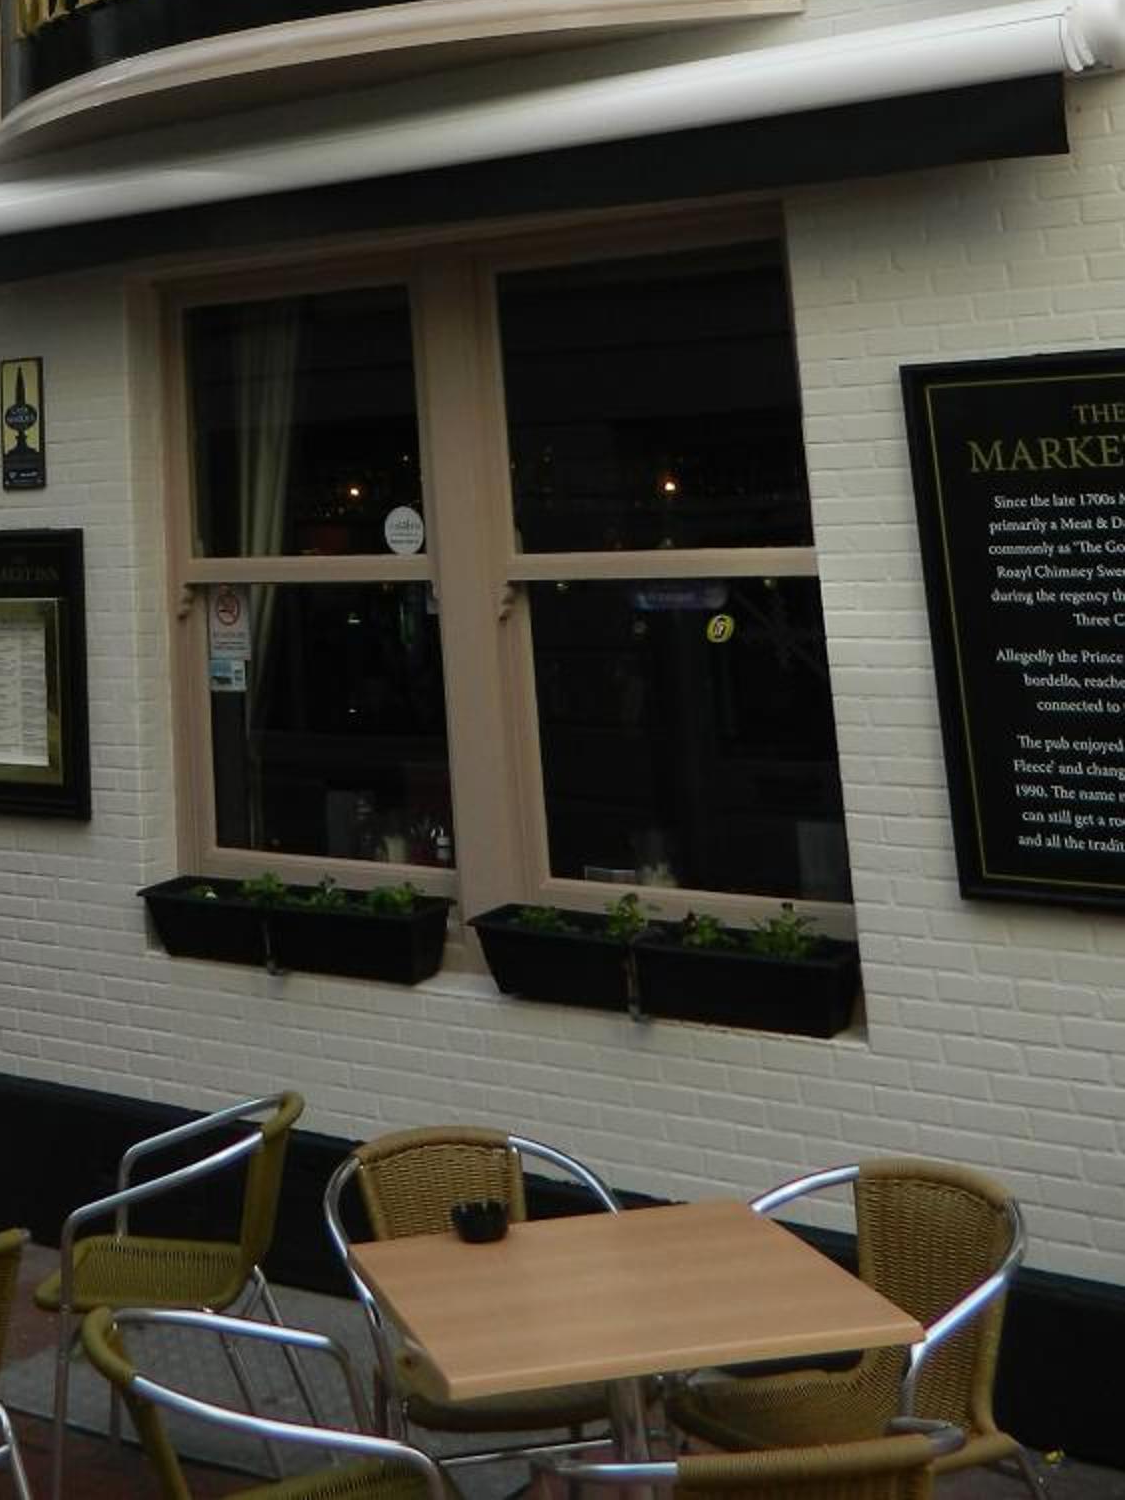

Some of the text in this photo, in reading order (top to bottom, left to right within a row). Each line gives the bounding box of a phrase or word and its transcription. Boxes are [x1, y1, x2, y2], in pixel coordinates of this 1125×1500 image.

[967, 435, 1125, 474] MARKE
[994, 495, 1028, 509] Since
[1030, 492, 1050, 507] the
[1052, 492, 1075, 507] late
[1079, 493, 1115, 506] 1700s
[988, 517, 1048, 536] primarily
[1060, 517, 1093, 531] Meat
[1096, 516, 1109, 530] &
[1111, 515, 1125, 530] D
[988, 541, 1055, 558] commonly
[1035, 563, 1093, 581] Chimney
[990, 587, 1034, 606] during
[1036, 587, 1056, 602] the
[1059, 591, 1110, 606] regency
[1072, 612, 1111, 627] Three
[996, 647, 1124, 667] Allegedly the Prince
[1036, 699, 1104, 713] connected
[1106, 700, 1121, 714] to
[1016, 734, 1124, 755] The pub enjoyed
[1058, 761, 1084, 775] and
[1016, 784, 1049, 798] 1990.
[1050, 785, 1076, 799] The
[1078, 789, 1116, 801] name
[1021, 810, 1045, 822] can
[1048, 809, 1073, 825] still
[1074, 813, 1095, 829] get
[1096, 816, 1106, 827] a
[1018, 833, 1043, 847] and
[1045, 833, 1062, 848] all
[1064, 835, 1086, 849] the
